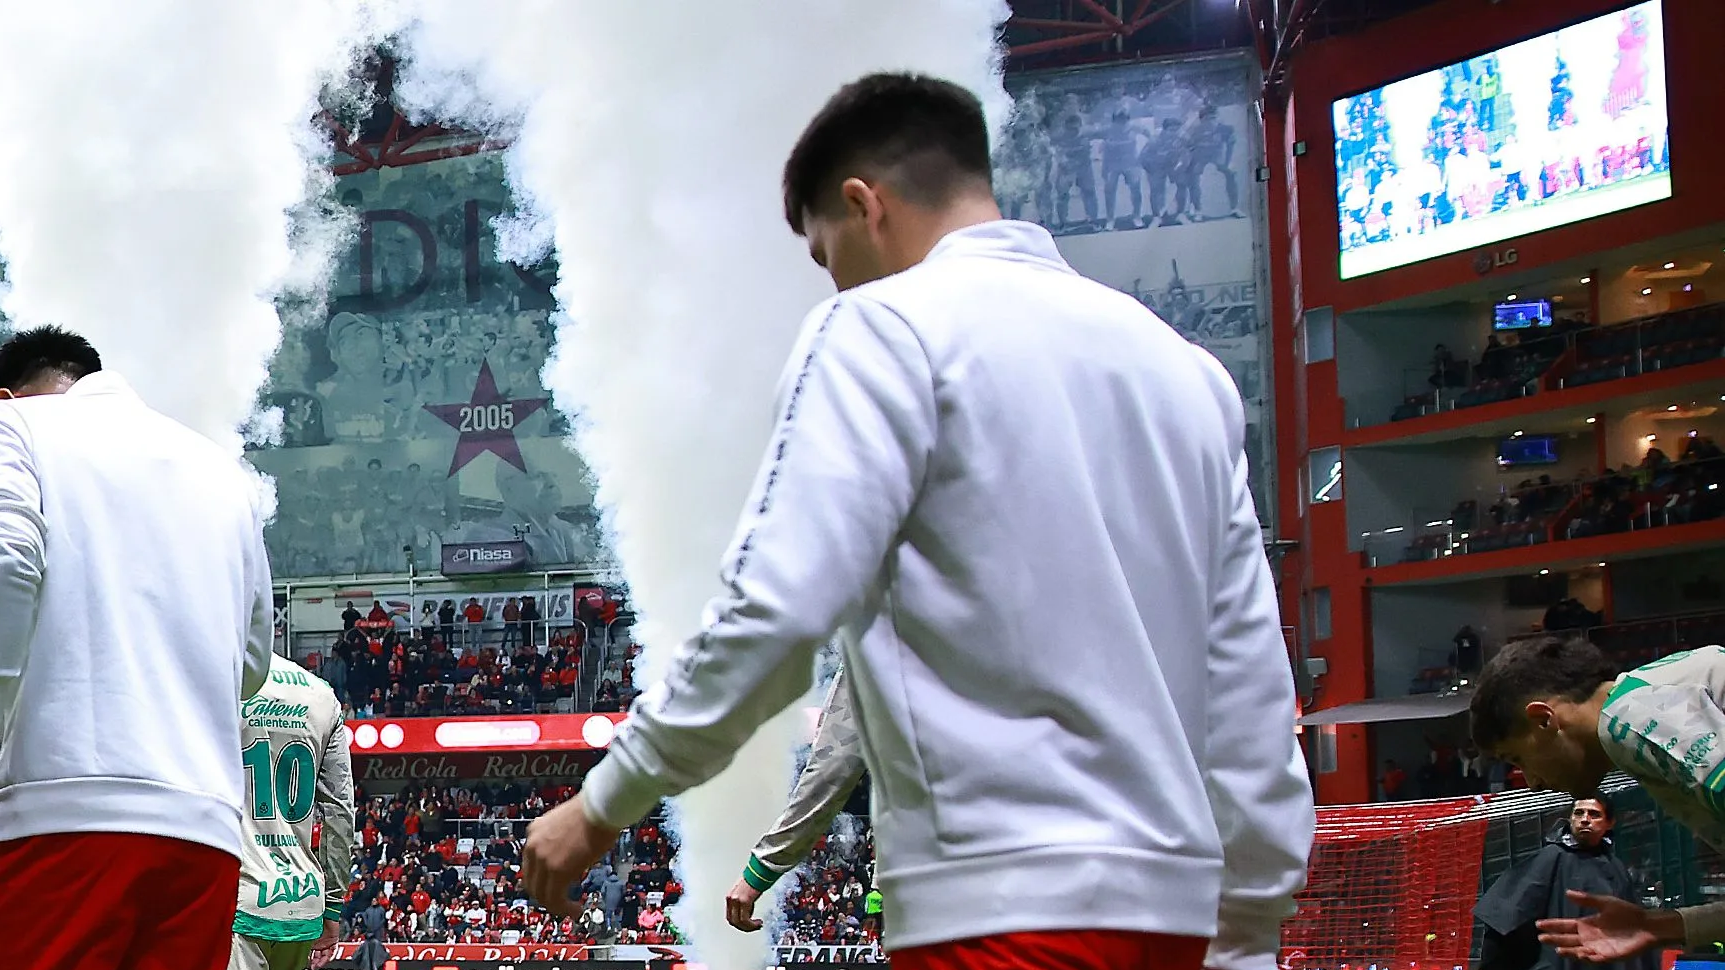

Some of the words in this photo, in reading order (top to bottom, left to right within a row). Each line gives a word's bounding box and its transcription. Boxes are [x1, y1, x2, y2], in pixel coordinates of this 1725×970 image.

[1495, 249, 1518, 267] LG
[459, 403, 514, 432] 2005
[248, 717, 308, 730] caliente.mx
[364, 756, 407, 780] Red
[411, 756, 458, 779] Cola
[483, 753, 528, 778] Red
[531, 749, 579, 777] Cola
[242, 737, 317, 824] 10
